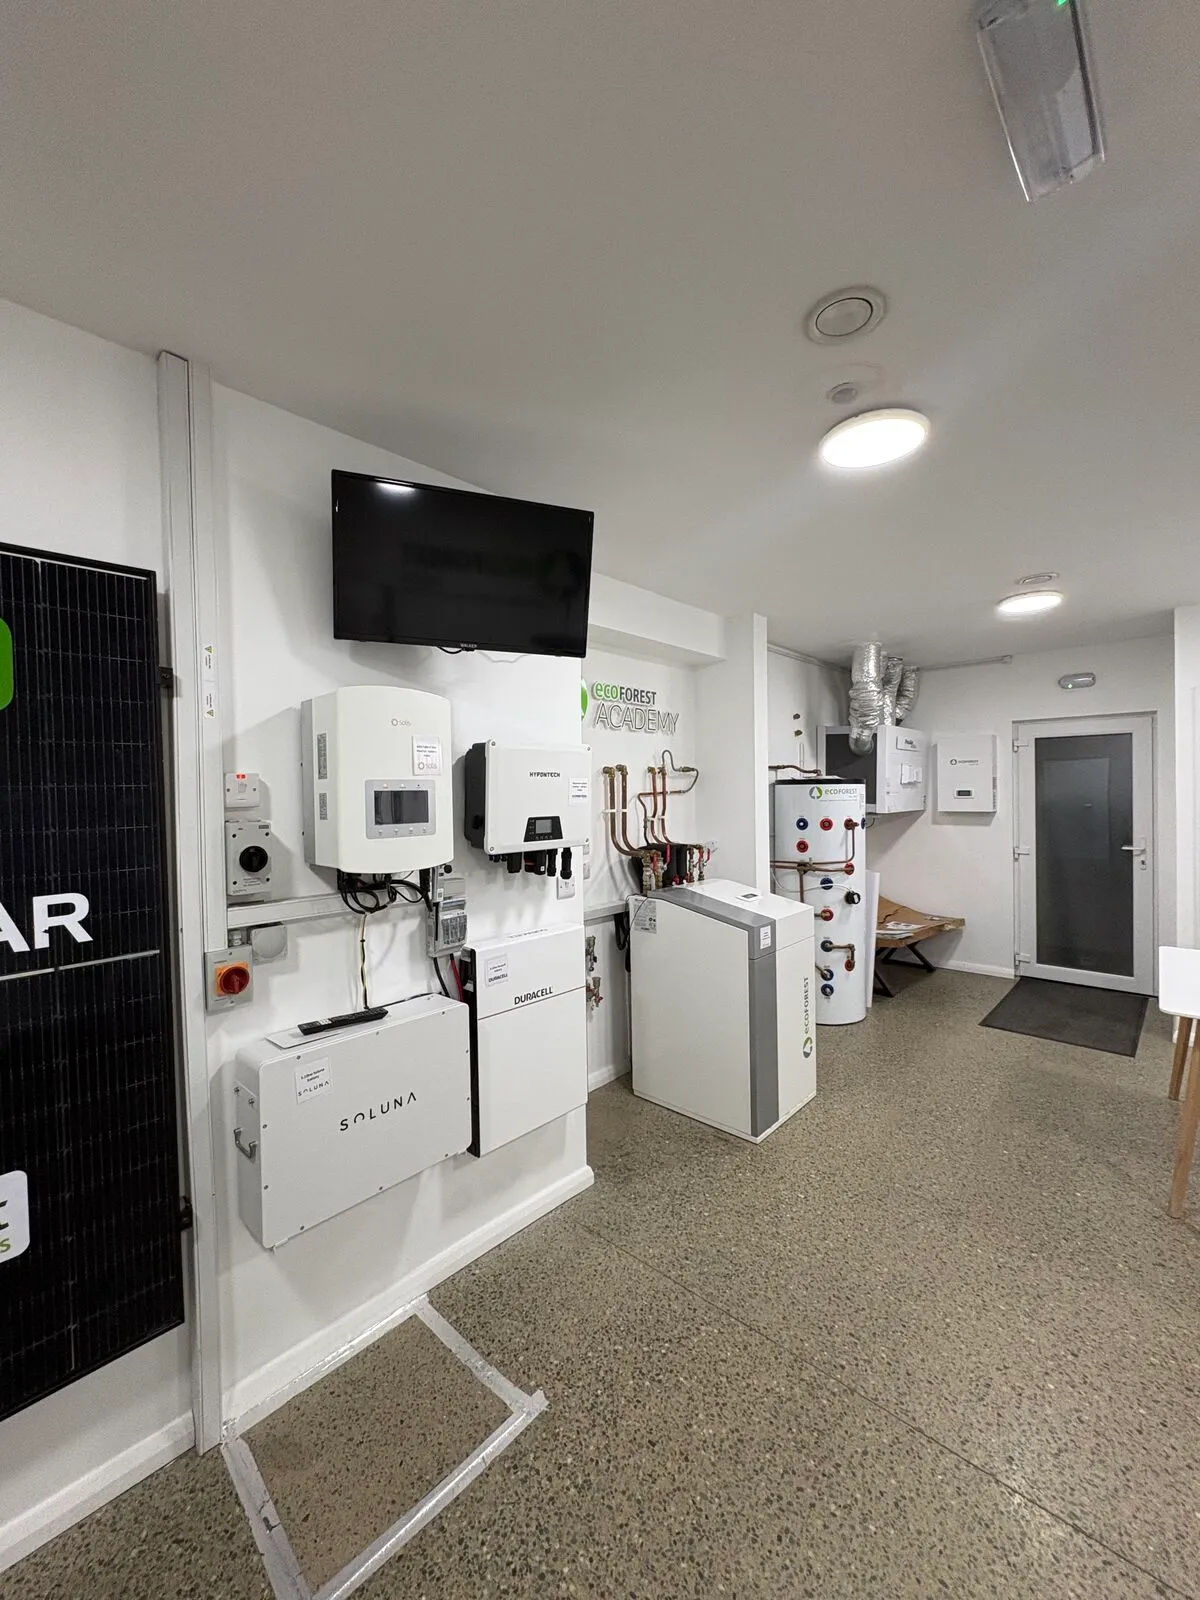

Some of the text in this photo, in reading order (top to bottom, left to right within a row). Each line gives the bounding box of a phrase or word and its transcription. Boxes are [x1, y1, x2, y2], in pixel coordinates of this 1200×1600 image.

[594, 681, 657, 705] ecoFOREST
[596, 702, 679, 732] ACADEMY
[514, 986, 553, 1005] DURACELL
[298, 1080, 330, 1097] SOLUNA
[340, 1091, 417, 1131] SOLUNA
